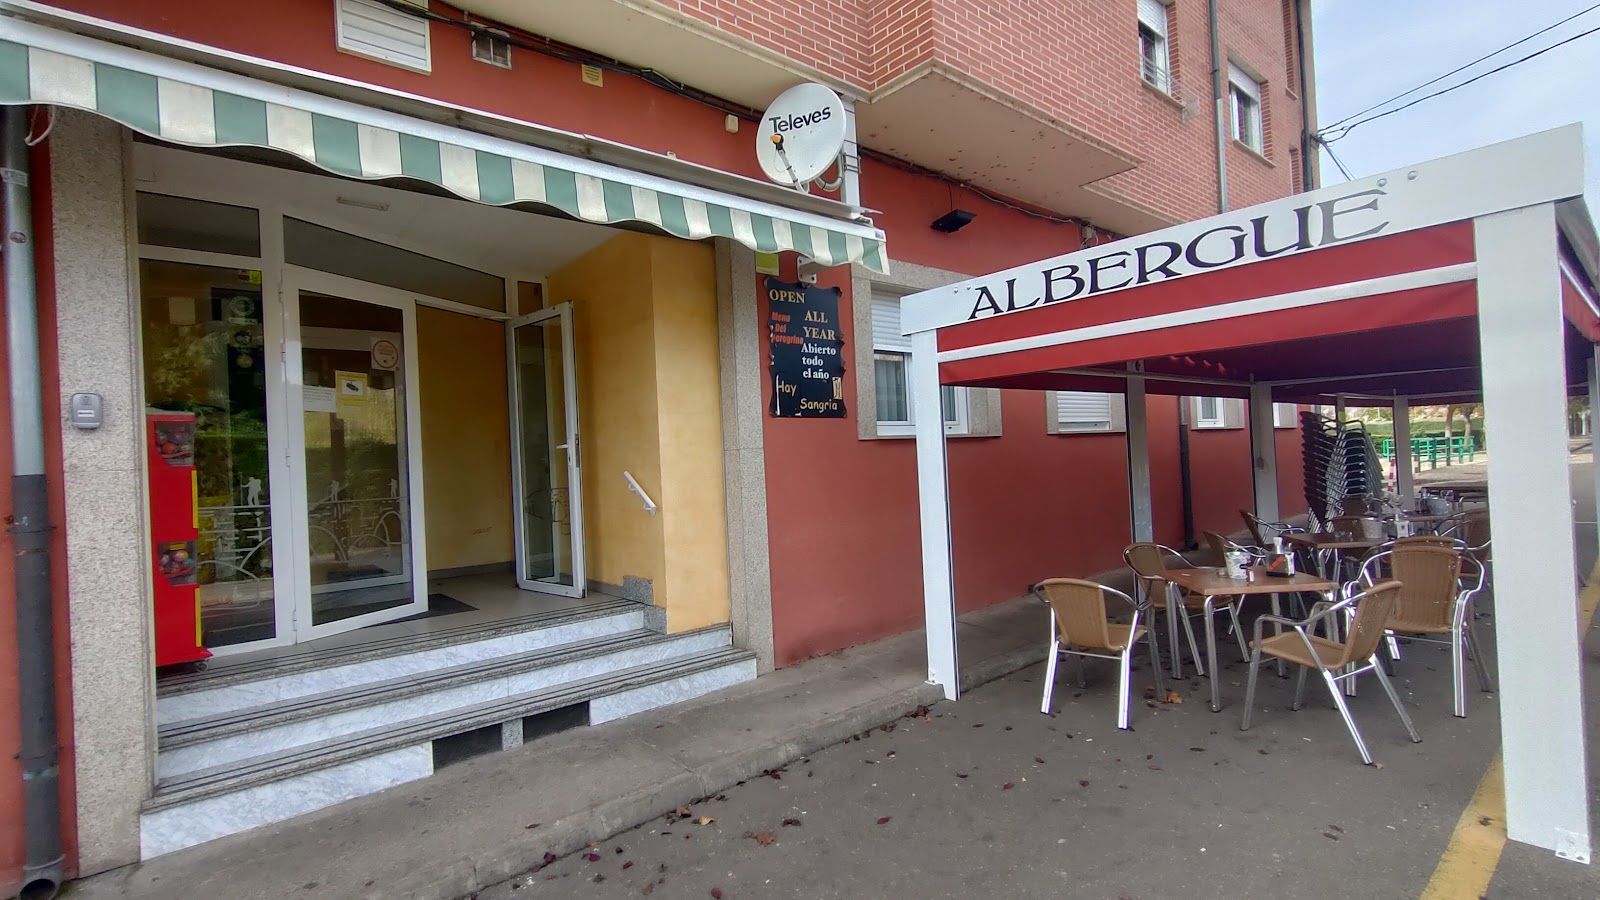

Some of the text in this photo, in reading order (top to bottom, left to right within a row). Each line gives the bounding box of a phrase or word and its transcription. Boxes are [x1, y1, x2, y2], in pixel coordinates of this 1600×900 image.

[769, 106, 831, 133] Televes
[967, 189, 1390, 320] ALBERGUE
[769, 289, 805, 304] OPEN
[804, 310, 828, 323] ALL
[775, 323, 787, 333] Del
[803, 326, 836, 341] YEAR
[801, 342, 837, 356] Abierto
[802, 356, 824, 367] todo
[803, 367, 830, 380] el año
[776, 380, 797, 397] Hay
